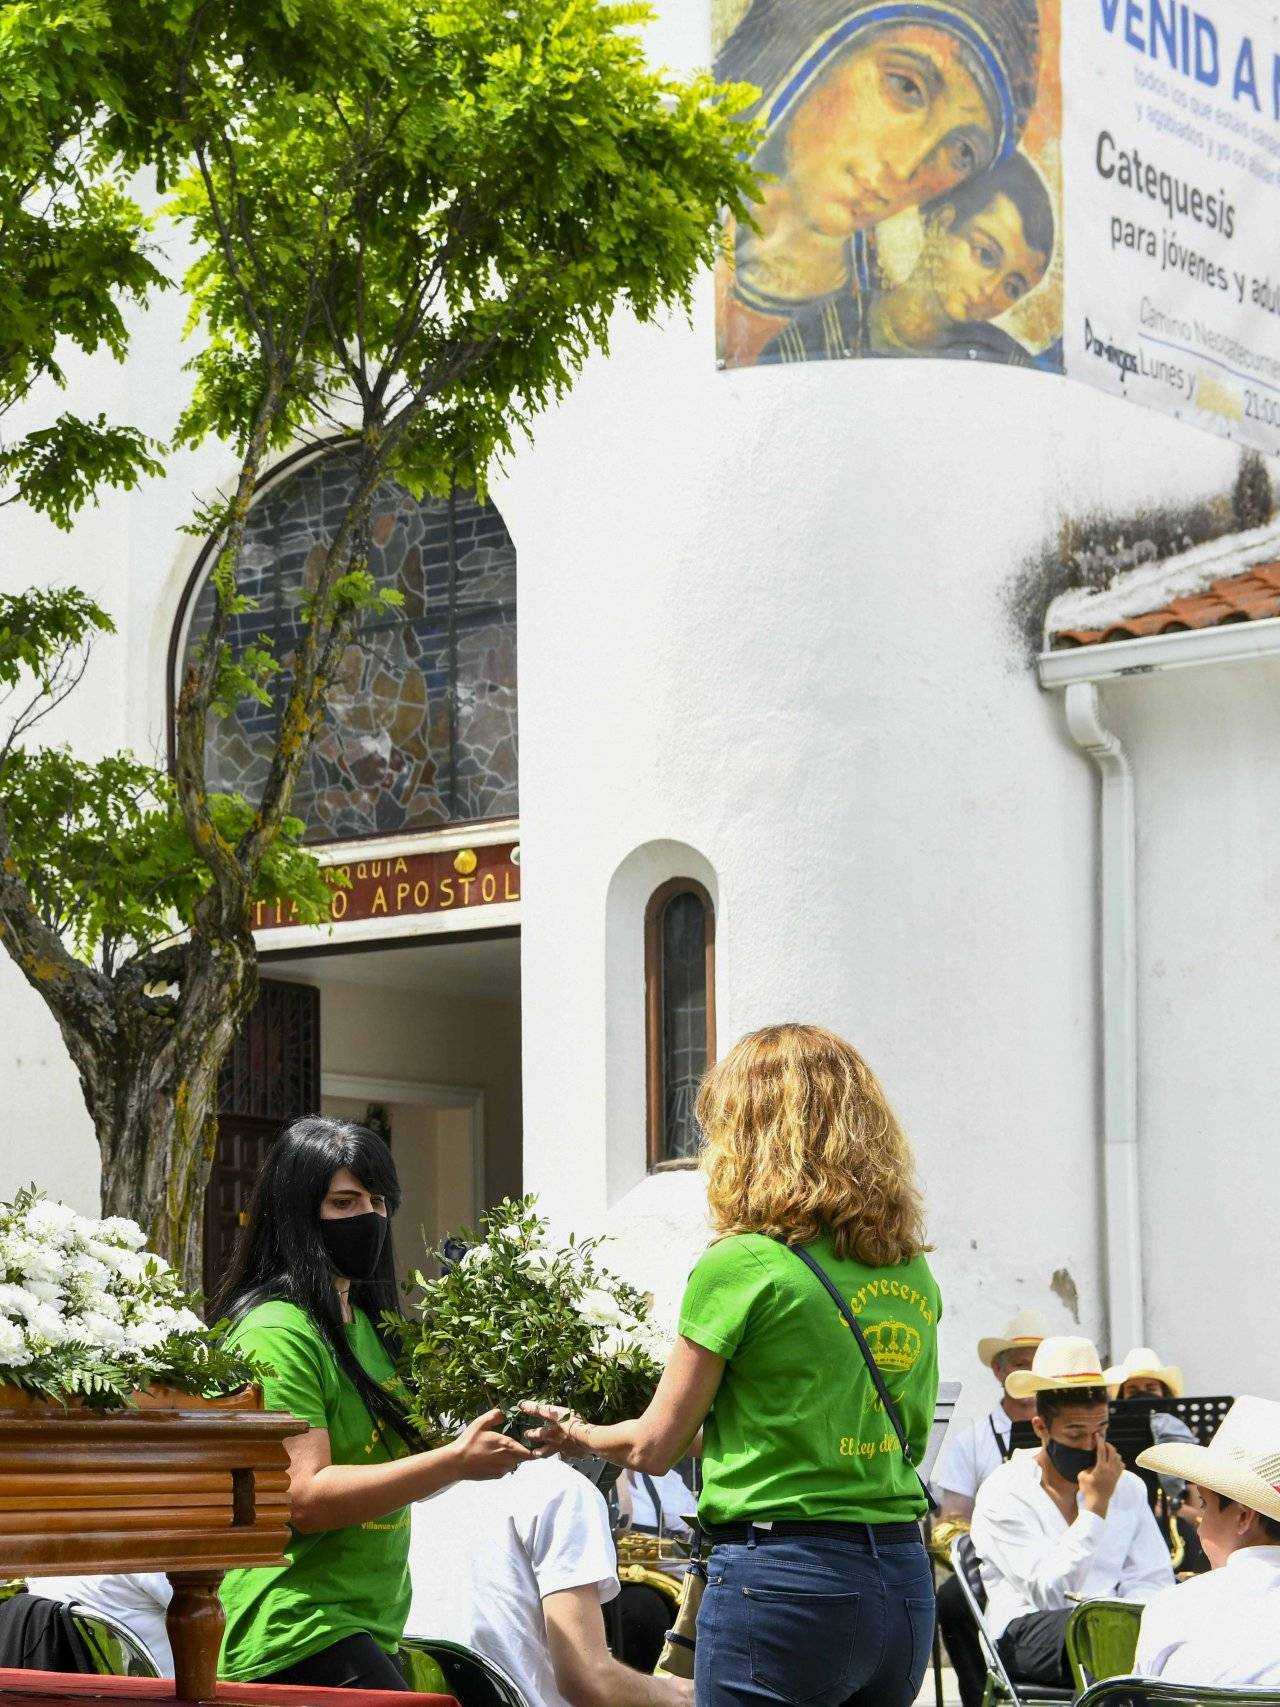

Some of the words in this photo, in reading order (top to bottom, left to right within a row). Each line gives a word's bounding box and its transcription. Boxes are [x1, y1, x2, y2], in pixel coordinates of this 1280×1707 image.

[1099, 0, 1220, 87] VENID
[1232, 36, 1262, 113] A
[1096, 131, 1236, 239] Catequesis
[1111, 216, 1157, 257] para
[1160, 228, 1228, 291] jóvenes
[1232, 271, 1246, 303] y
[1138, 347, 1185, 390] Lunes
[1186, 371, 1197, 401] y
[371, 871, 519, 915] APOSTOL
